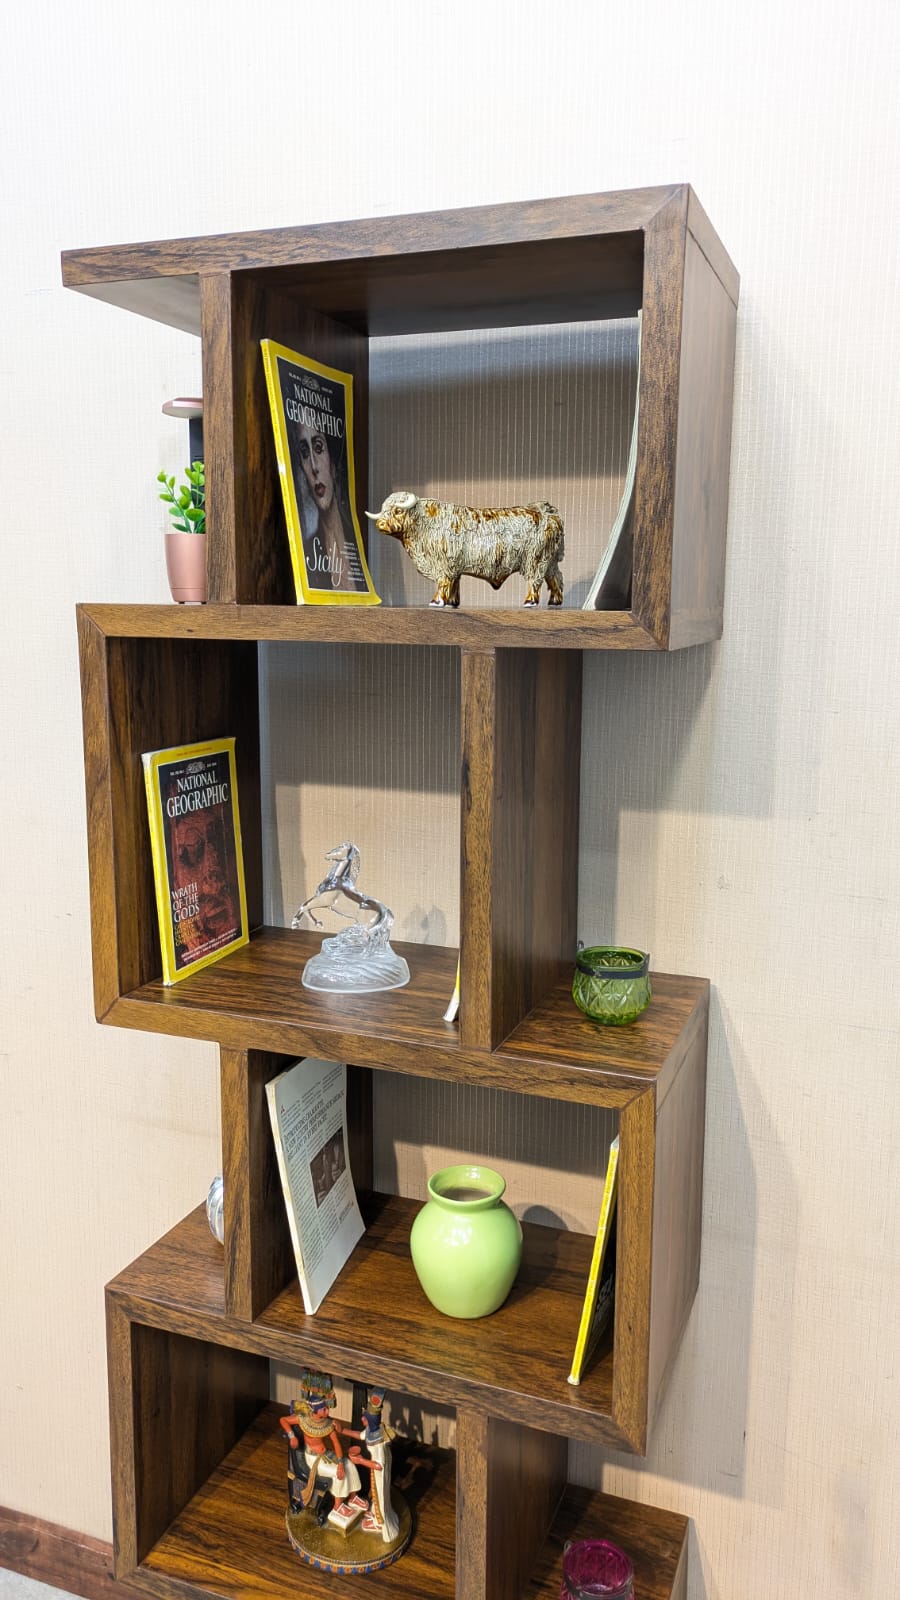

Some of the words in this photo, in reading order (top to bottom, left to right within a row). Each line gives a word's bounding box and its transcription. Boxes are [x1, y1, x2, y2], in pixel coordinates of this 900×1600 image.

[294, 384, 333, 413] NATIONAL
[286, 398, 342, 438] GEOGRAPHIC
[306, 537, 344, 587] Sicily
[177, 770, 218, 793] NATIONAL
[166, 783, 228, 818] GEOGRAPHIC
[171, 882, 198, 900] WRATH
[172, 897, 183, 911] OF
[183, 892, 199, 907] THE
[173, 903, 200, 923] GODS
